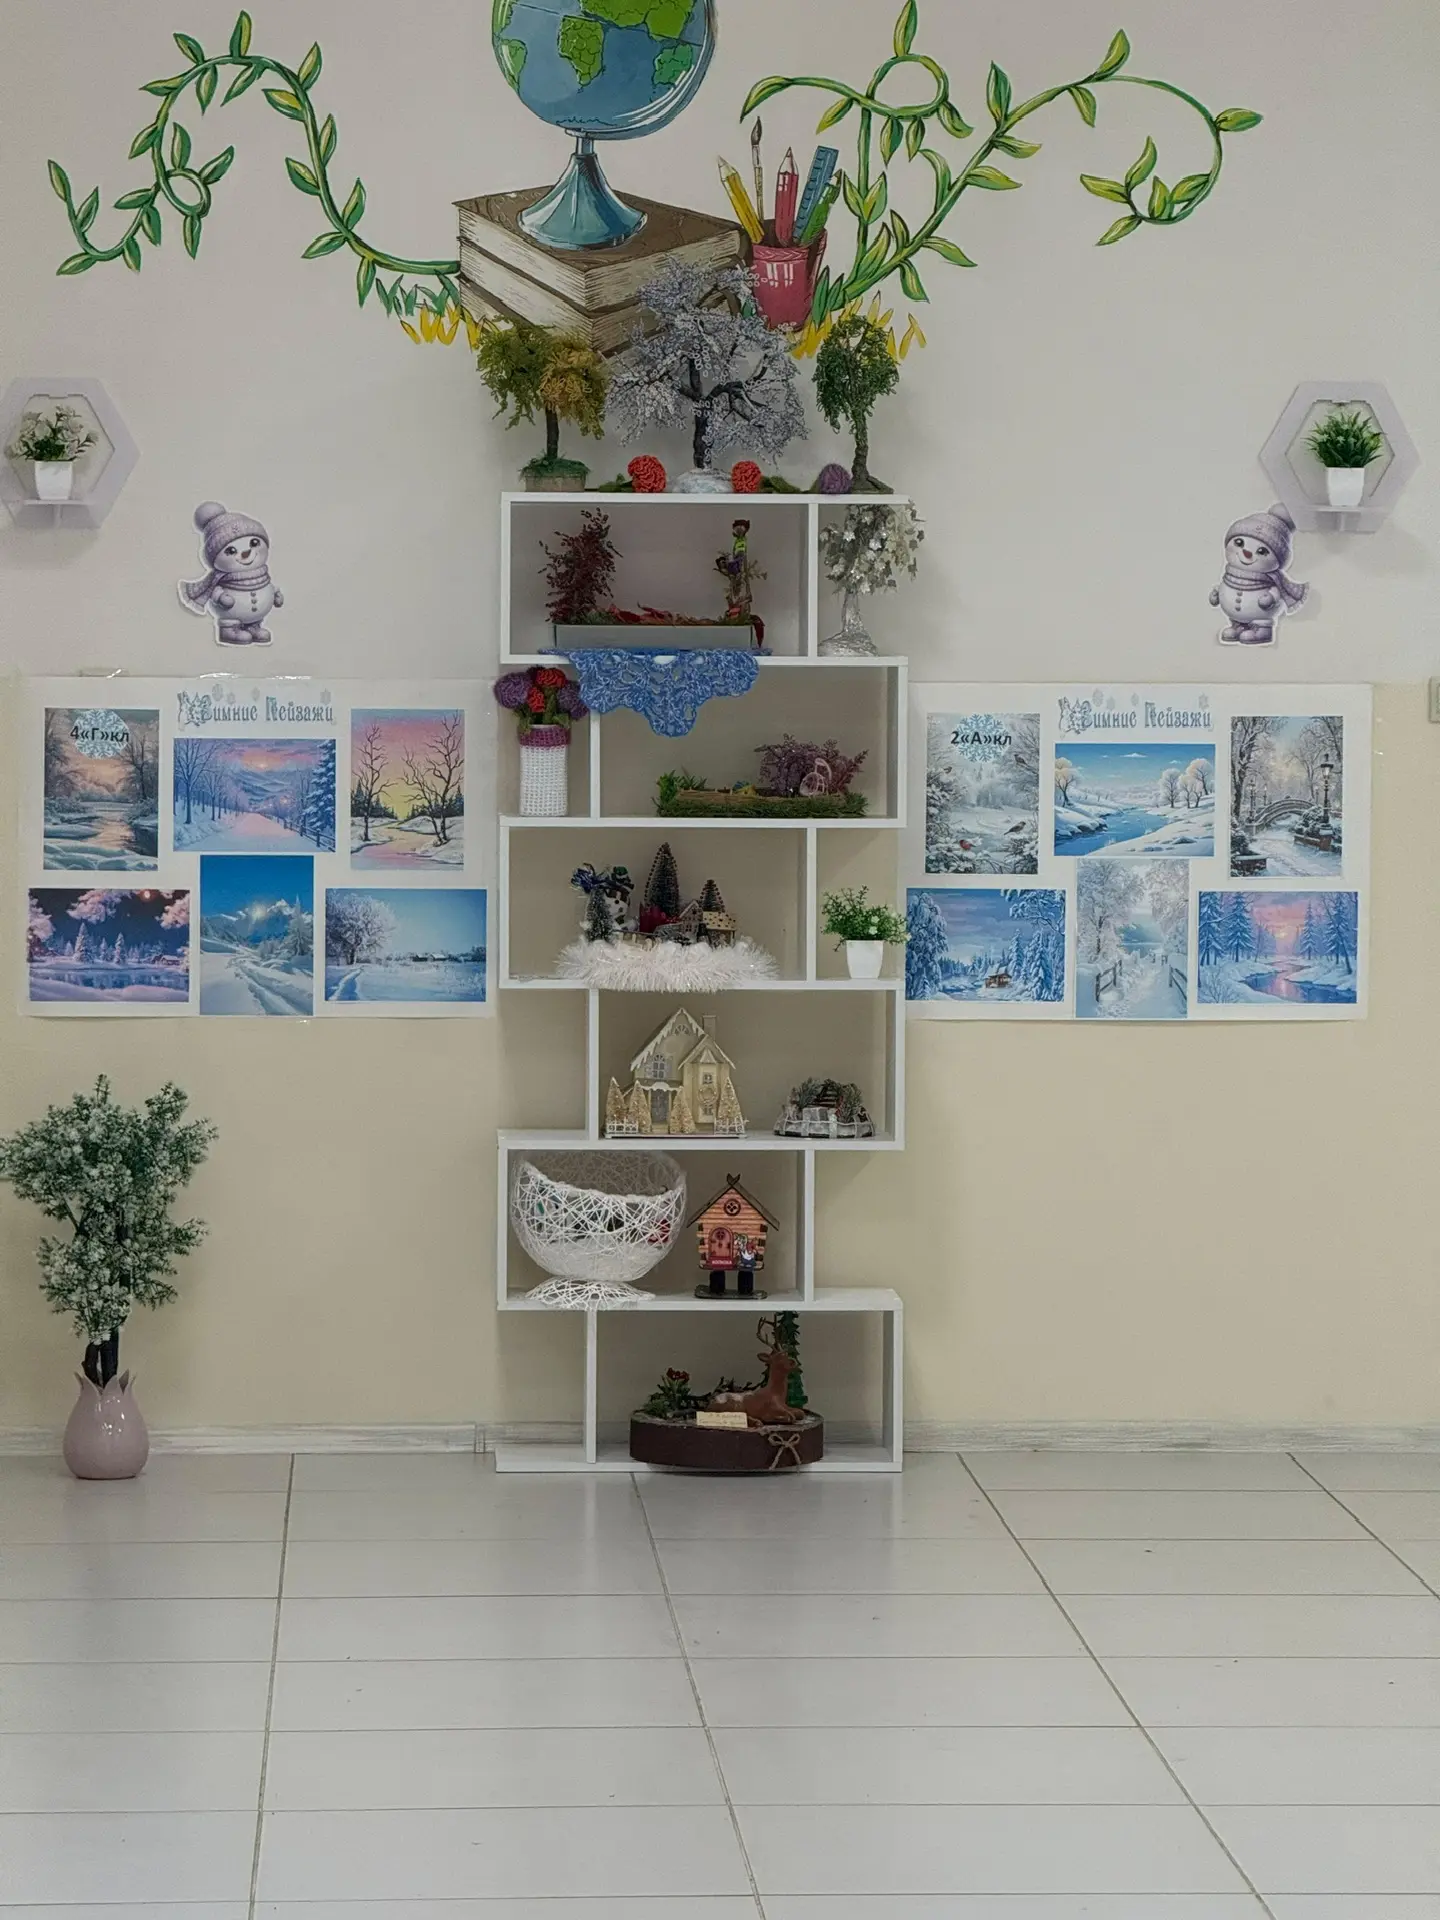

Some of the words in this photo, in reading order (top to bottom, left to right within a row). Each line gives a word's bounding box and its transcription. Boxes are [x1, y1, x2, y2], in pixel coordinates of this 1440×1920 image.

[196, 693, 258, 725] Зимние
[265, 695, 334, 722] Пейзажи
[1077, 699, 1138, 731] Зимние
[1144, 701, 1212, 729] Пейзажи
[70, 725, 130, 742] 4«Г»кл
[950, 730, 1012, 746] 2«А»кл
